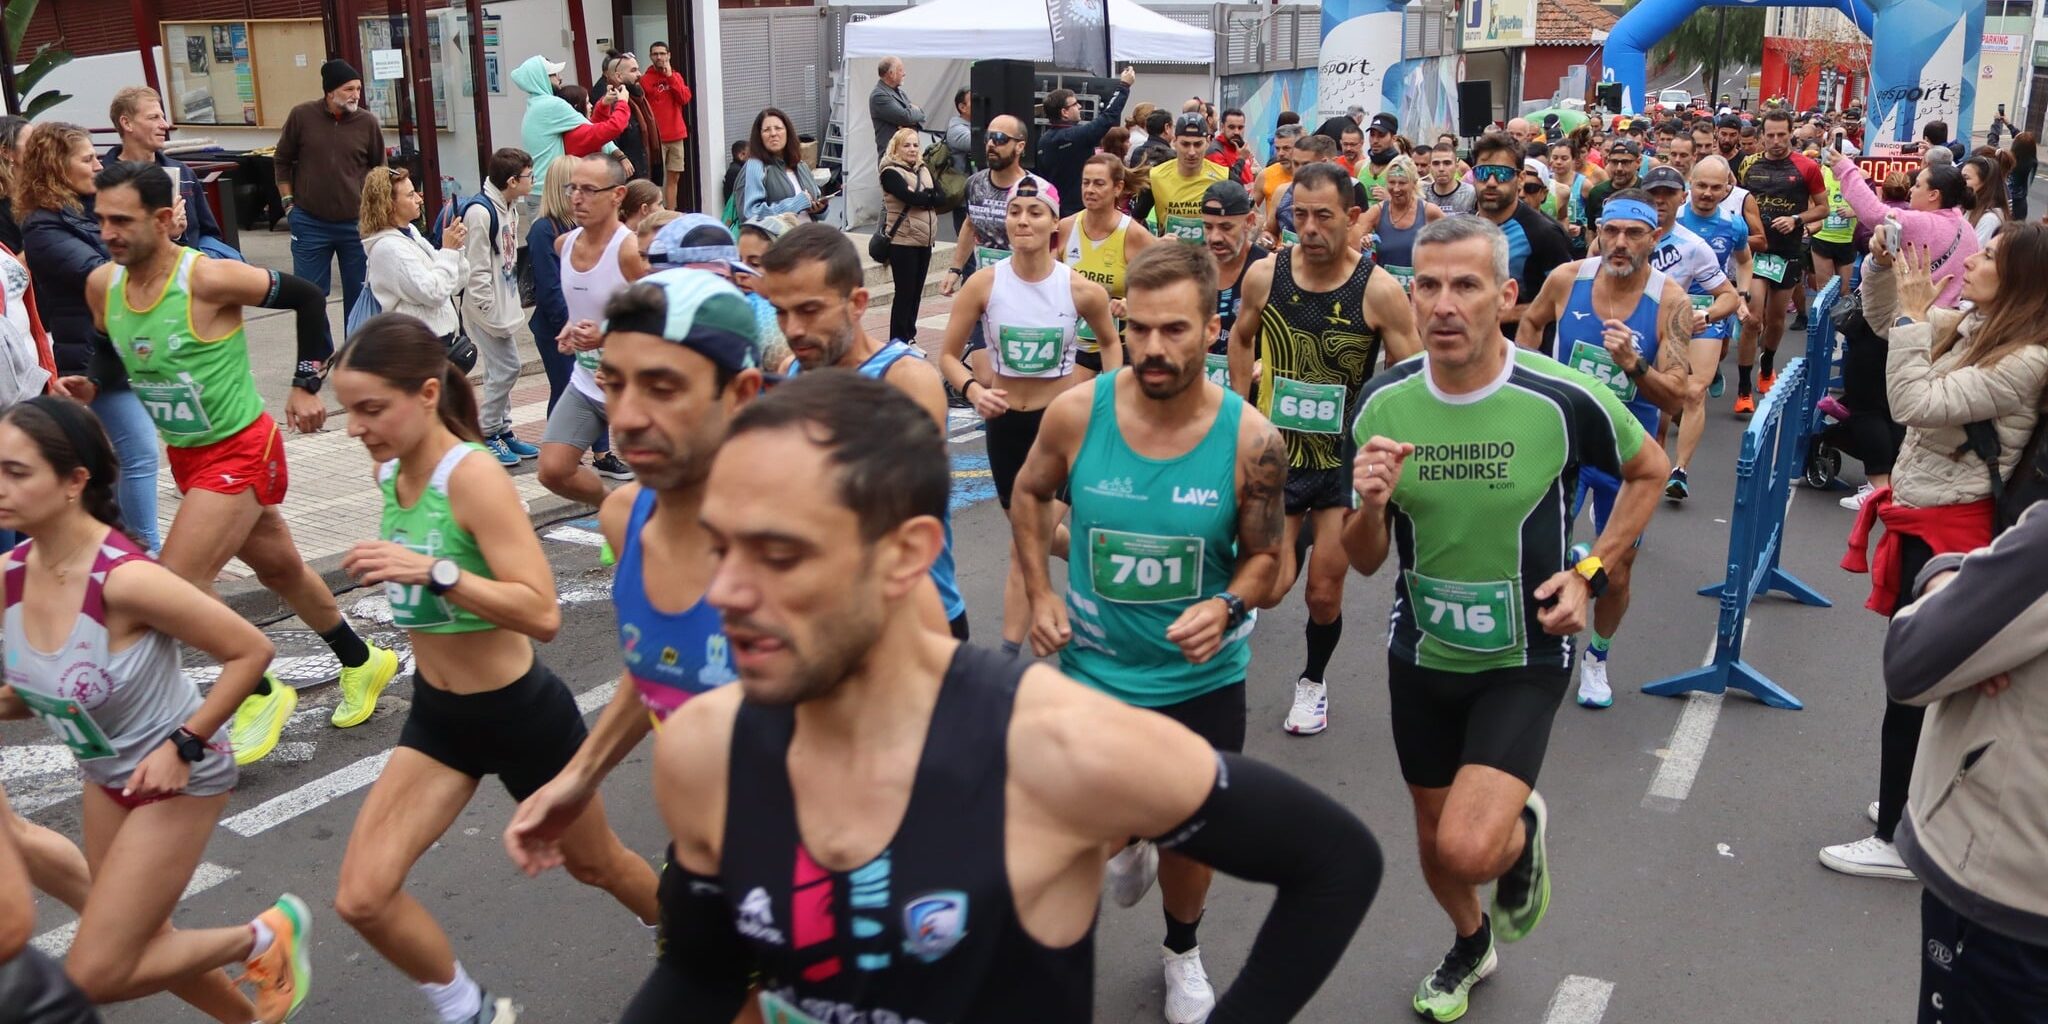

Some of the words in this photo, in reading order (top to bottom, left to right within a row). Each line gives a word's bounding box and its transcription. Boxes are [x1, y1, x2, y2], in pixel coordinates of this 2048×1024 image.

[1172, 225, 1202, 239] 729
[1073, 268, 1114, 284] ORRE
[1007, 340, 1055, 362] 574
[1579, 358, 1629, 390] 554
[1280, 395, 1336, 421] 688
[1414, 442, 1515, 462] PROHIBIDO
[1419, 462, 1508, 481] RENDIRSE
[1110, 554, 1182, 586] 701
[1424, 596, 1496, 634] 716
